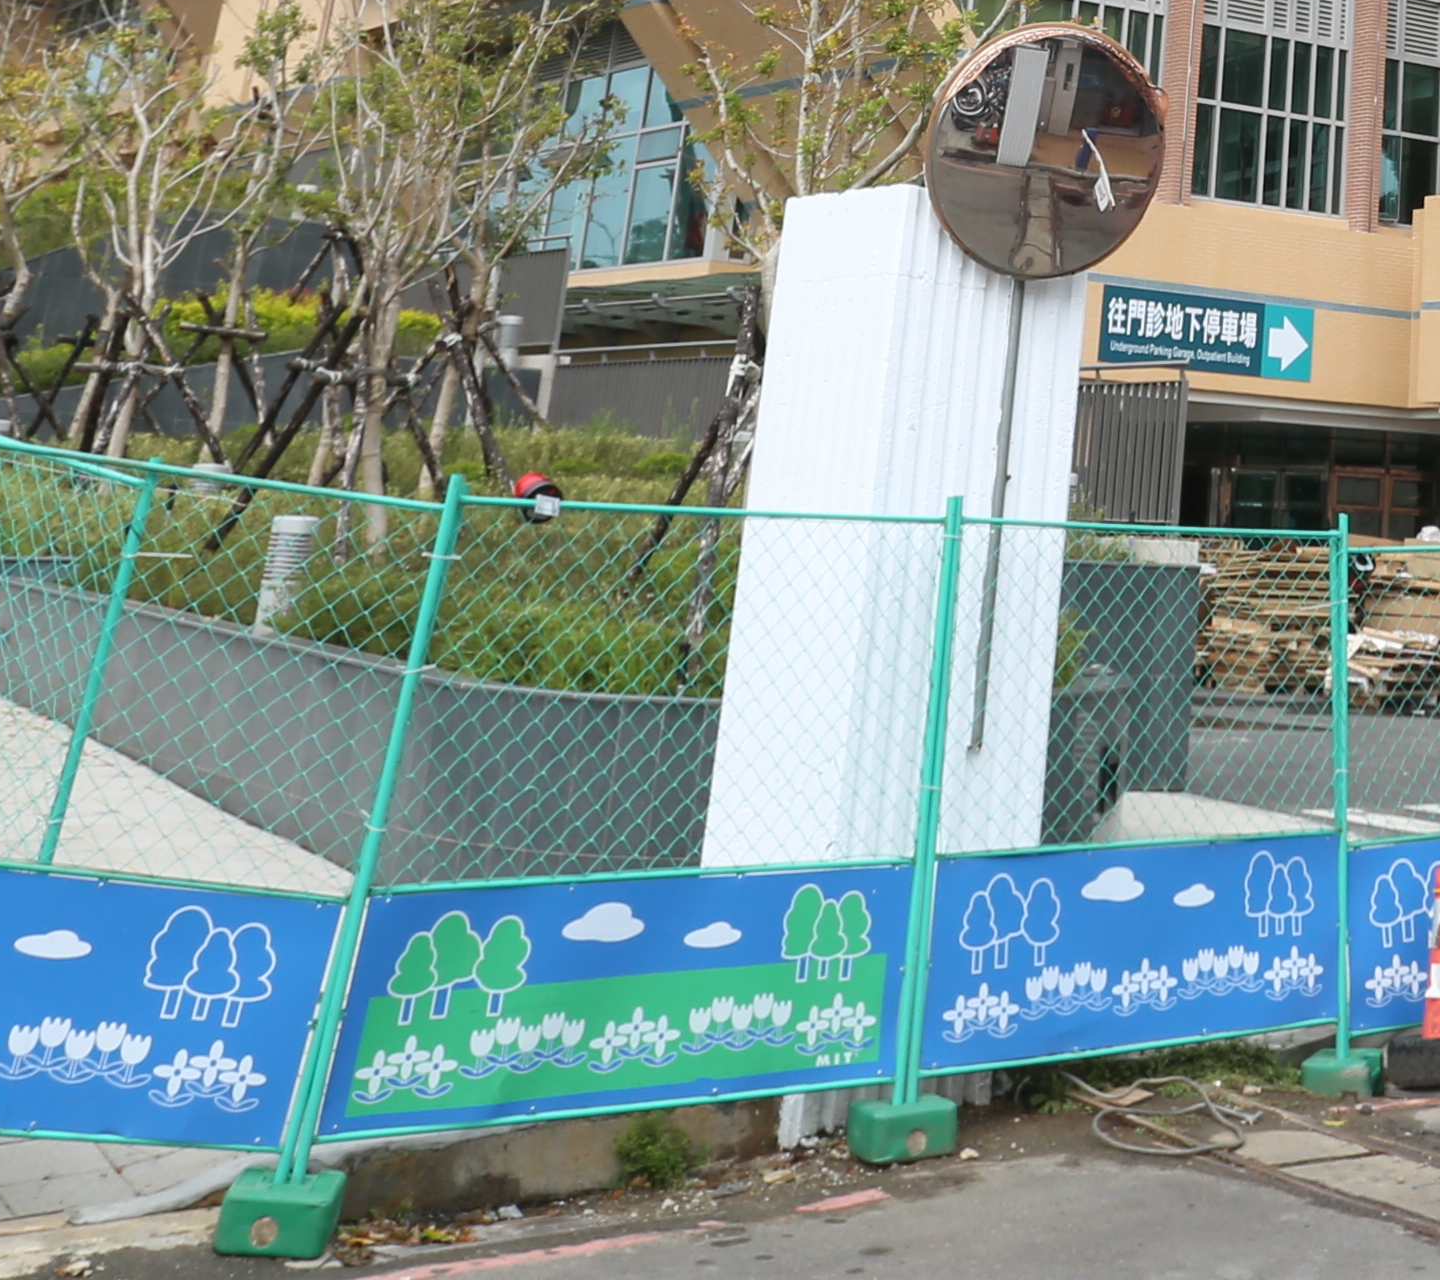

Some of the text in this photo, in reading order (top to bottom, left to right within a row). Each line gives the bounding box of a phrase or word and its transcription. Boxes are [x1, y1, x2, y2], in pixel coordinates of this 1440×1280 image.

[1107, 296, 1258, 349] 往門診地下停車場
[1110, 340, 1149, 356] Underground
[1150, 344, 1172, 359] Parking
[1196, 349, 1227, 363] Outpatient
[1227, 351, 1251, 367] Building
